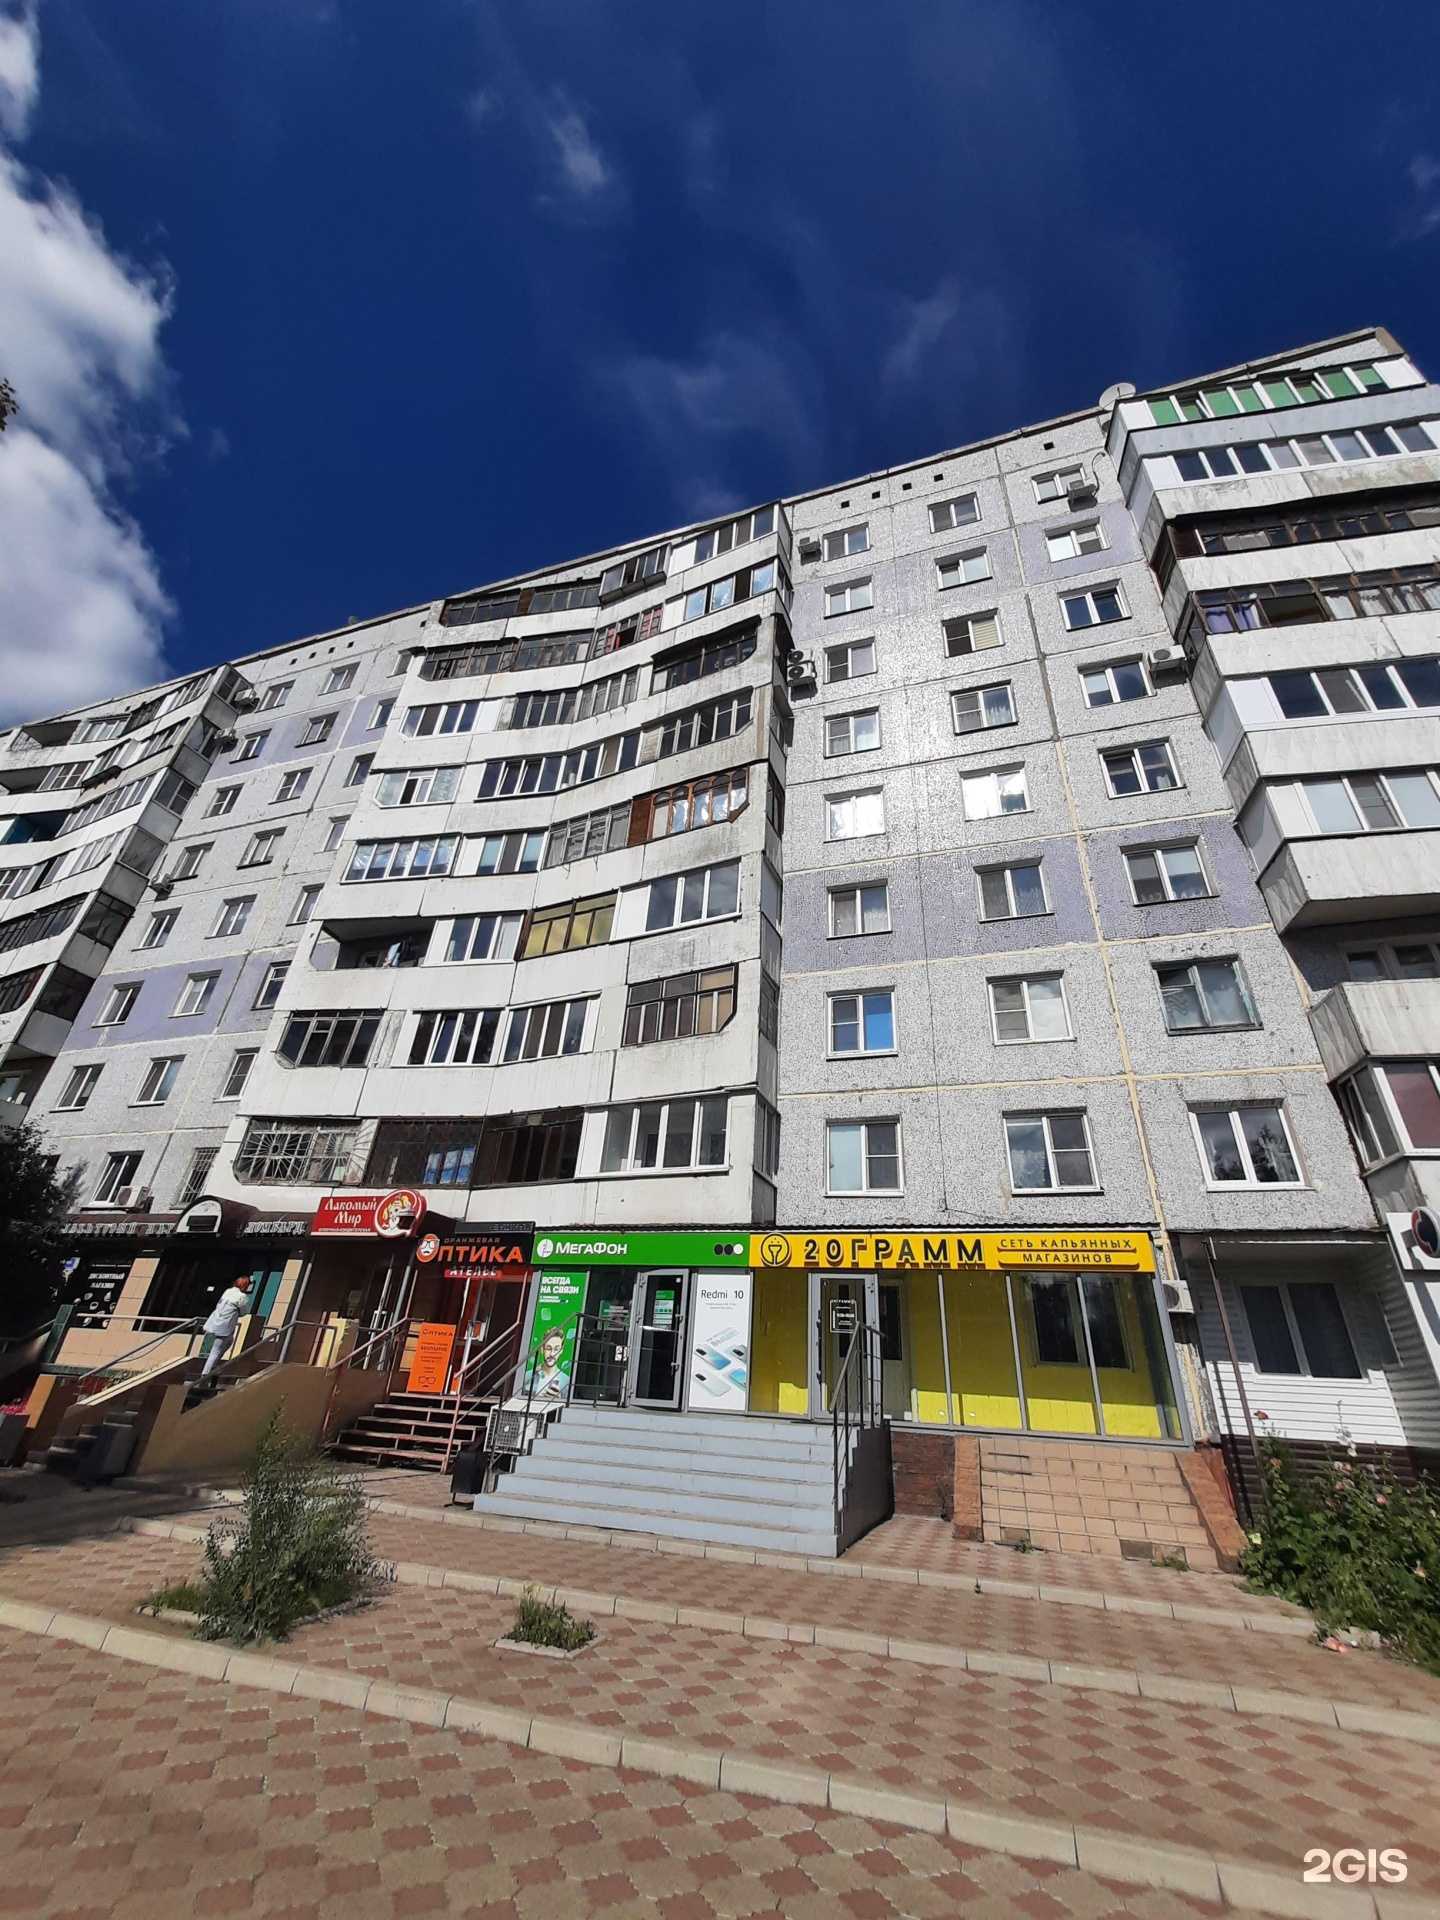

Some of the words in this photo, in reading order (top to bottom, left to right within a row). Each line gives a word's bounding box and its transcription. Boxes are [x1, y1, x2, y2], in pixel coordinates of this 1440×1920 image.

[324, 1197, 376, 1211] Лакомый
[333, 1211, 361, 1227] Мир
[444, 1236, 501, 1244] ОРАНЖЕВАЯ
[1000, 1239, 1033, 1248] СЕТЬ
[555, 1241, 628, 1255] МЕГАФОН
[1023, 1253, 1112, 1263] МАГАЗИНОВ
[542, 1276, 571, 1285] ВСЕГДА
[540, 1286, 551, 1294] НА
[553, 1286, 580, 1294] СВЯЗИ
[700, 1289, 728, 1299] Redmi
[734, 1290, 744, 1299] 10
